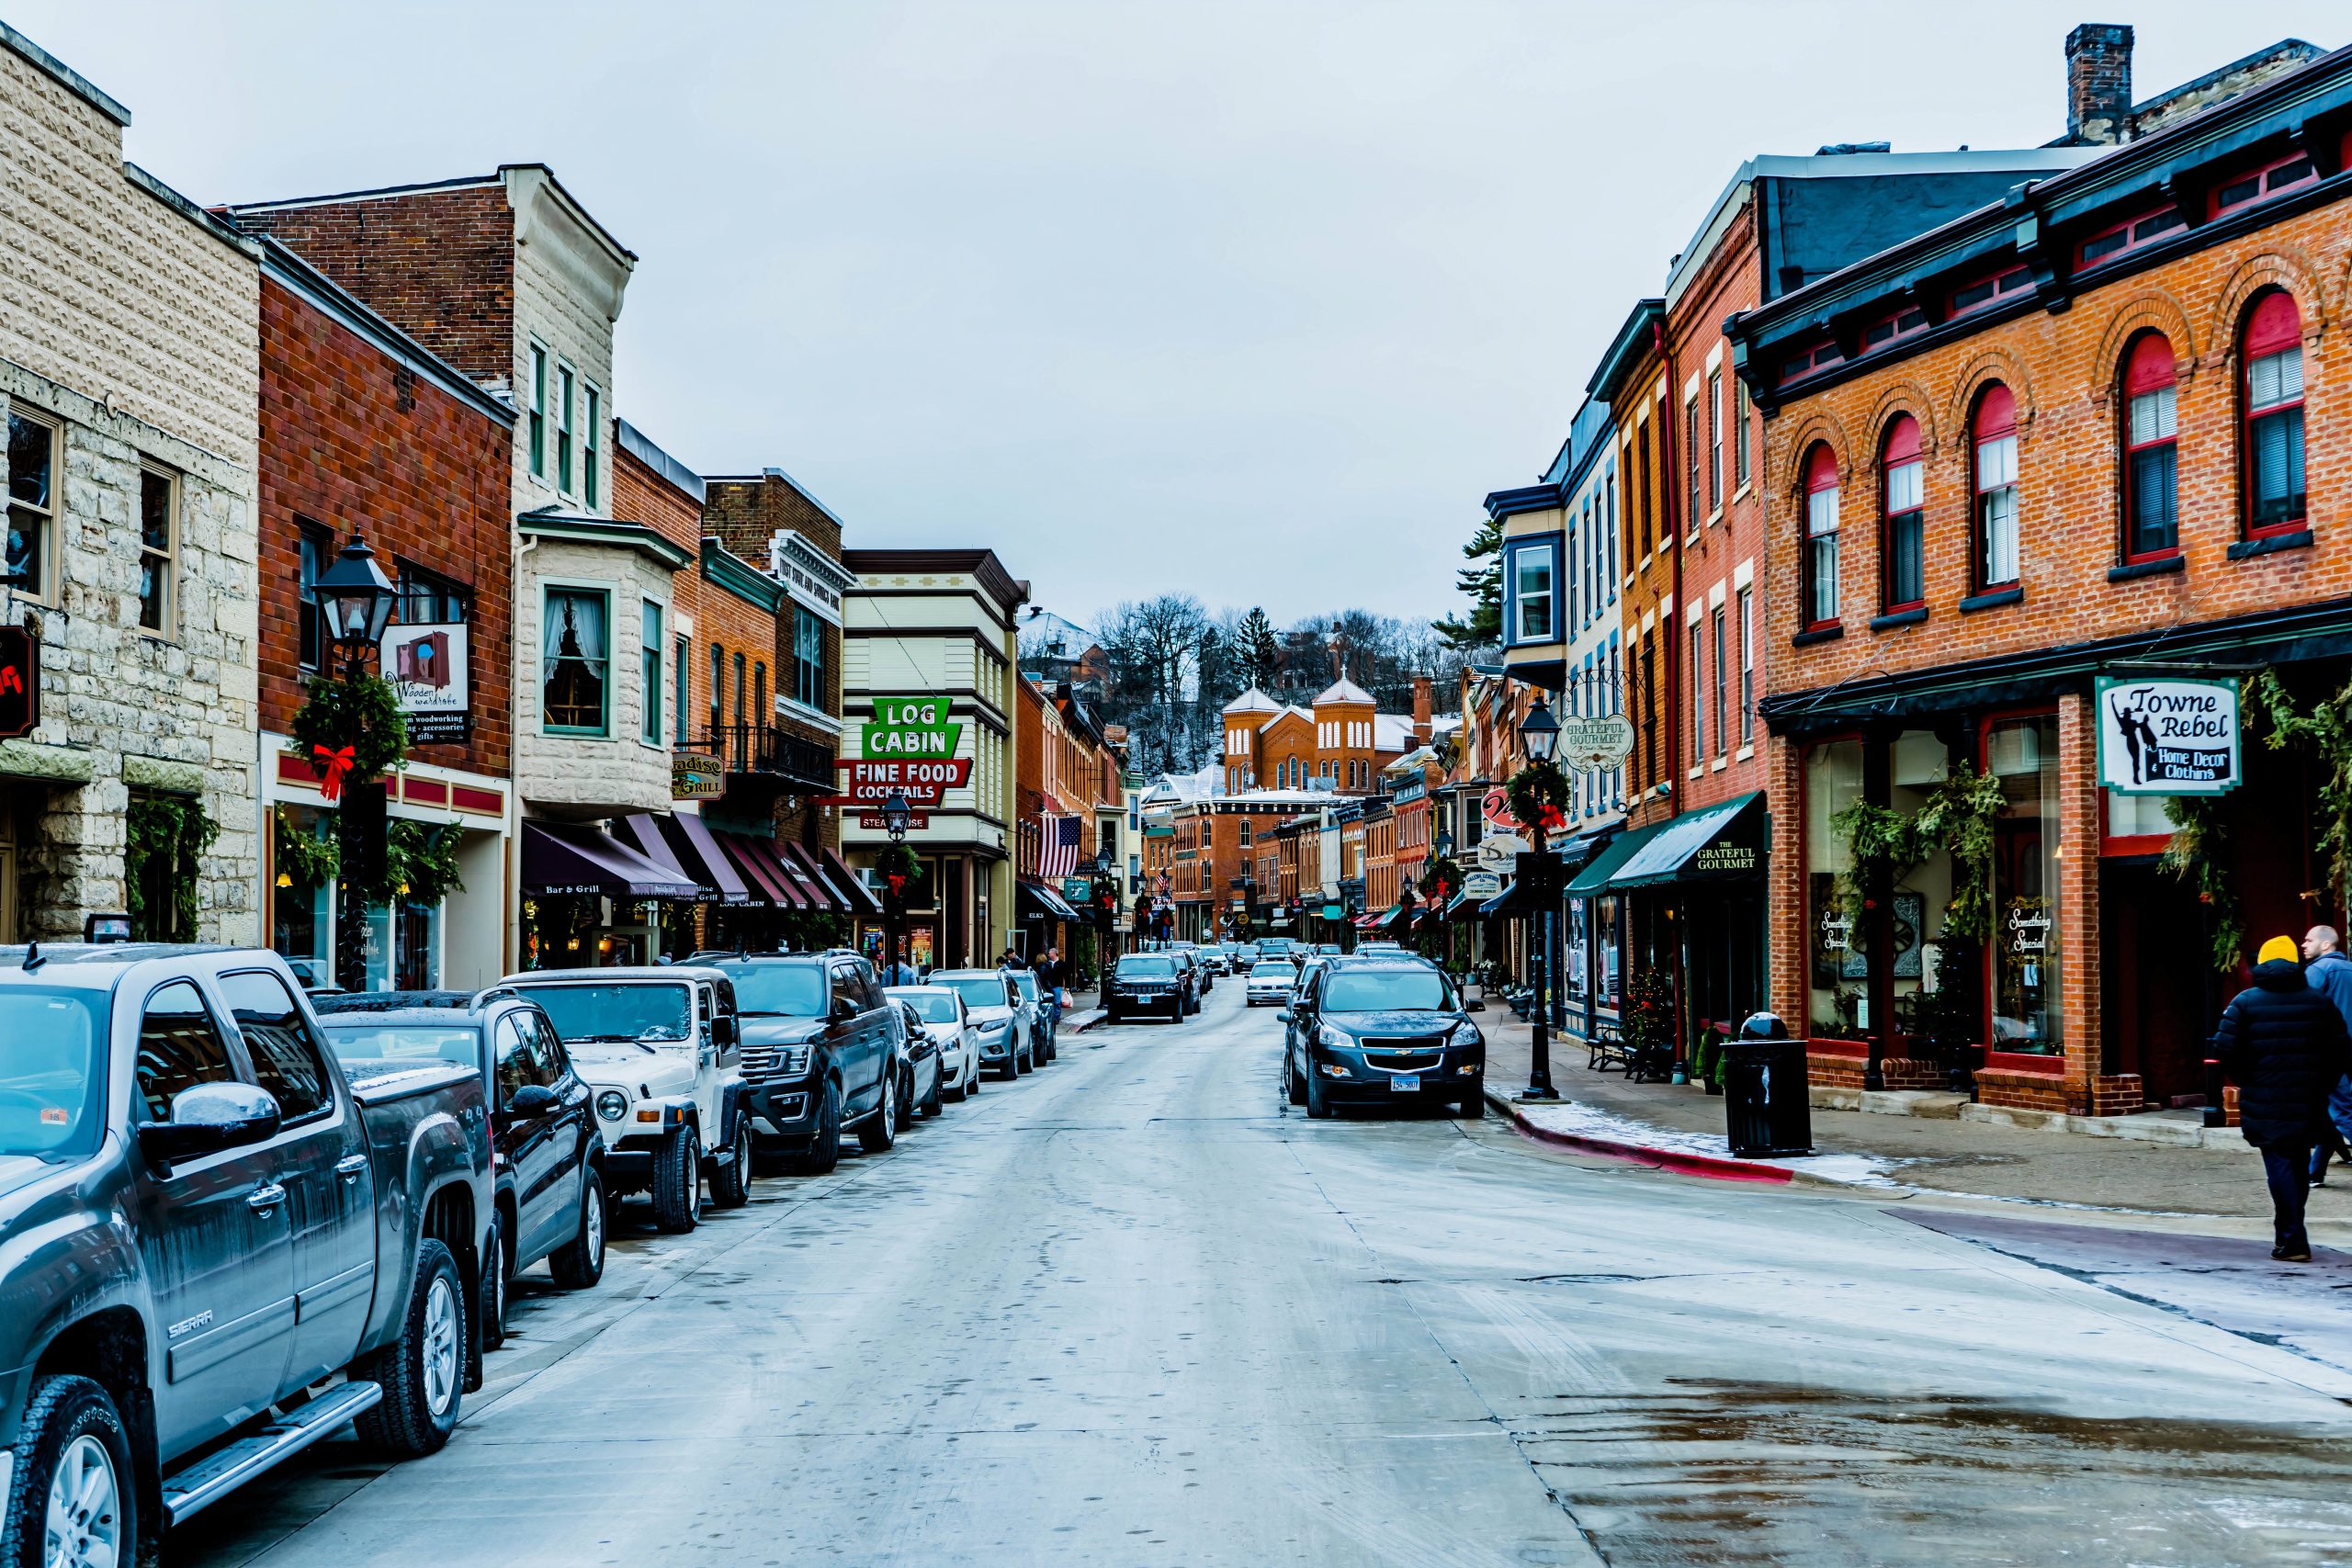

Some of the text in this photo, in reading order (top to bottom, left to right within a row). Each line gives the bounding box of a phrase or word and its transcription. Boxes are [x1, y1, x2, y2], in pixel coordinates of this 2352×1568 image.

[385, 671, 434, 705] Wooden
[414, 694, 458, 706] wardrobe
[2130, 687, 2217, 713] Towne
[415, 715, 463, 724] woodworking
[888, 705, 935, 725] LOG
[423, 723, 465, 732] accessories
[1566, 724, 1625, 735] GRATEFUL
[2161, 715, 2228, 738] Rebel
[416, 732, 434, 740] gifts
[870, 731, 945, 752] CABIN
[1570, 734, 1623, 745] GOURMET
[672, 756, 722, 777] radise
[2158, 749, 2228, 767] Home Decor
[855, 764, 957, 783] FINE FOOD
[2165, 764, 2216, 780] Clothing
[1697, 848, 1756, 859] GRATEFUL
[1697, 858, 1755, 870] GOURMET
[566, 885, 574, 894] &
[576, 885, 600, 893] Grill
[2009, 908, 2052, 931] Something
[2014, 930, 2047, 953] Special
[169, 1309, 213, 1339] SIERRA
